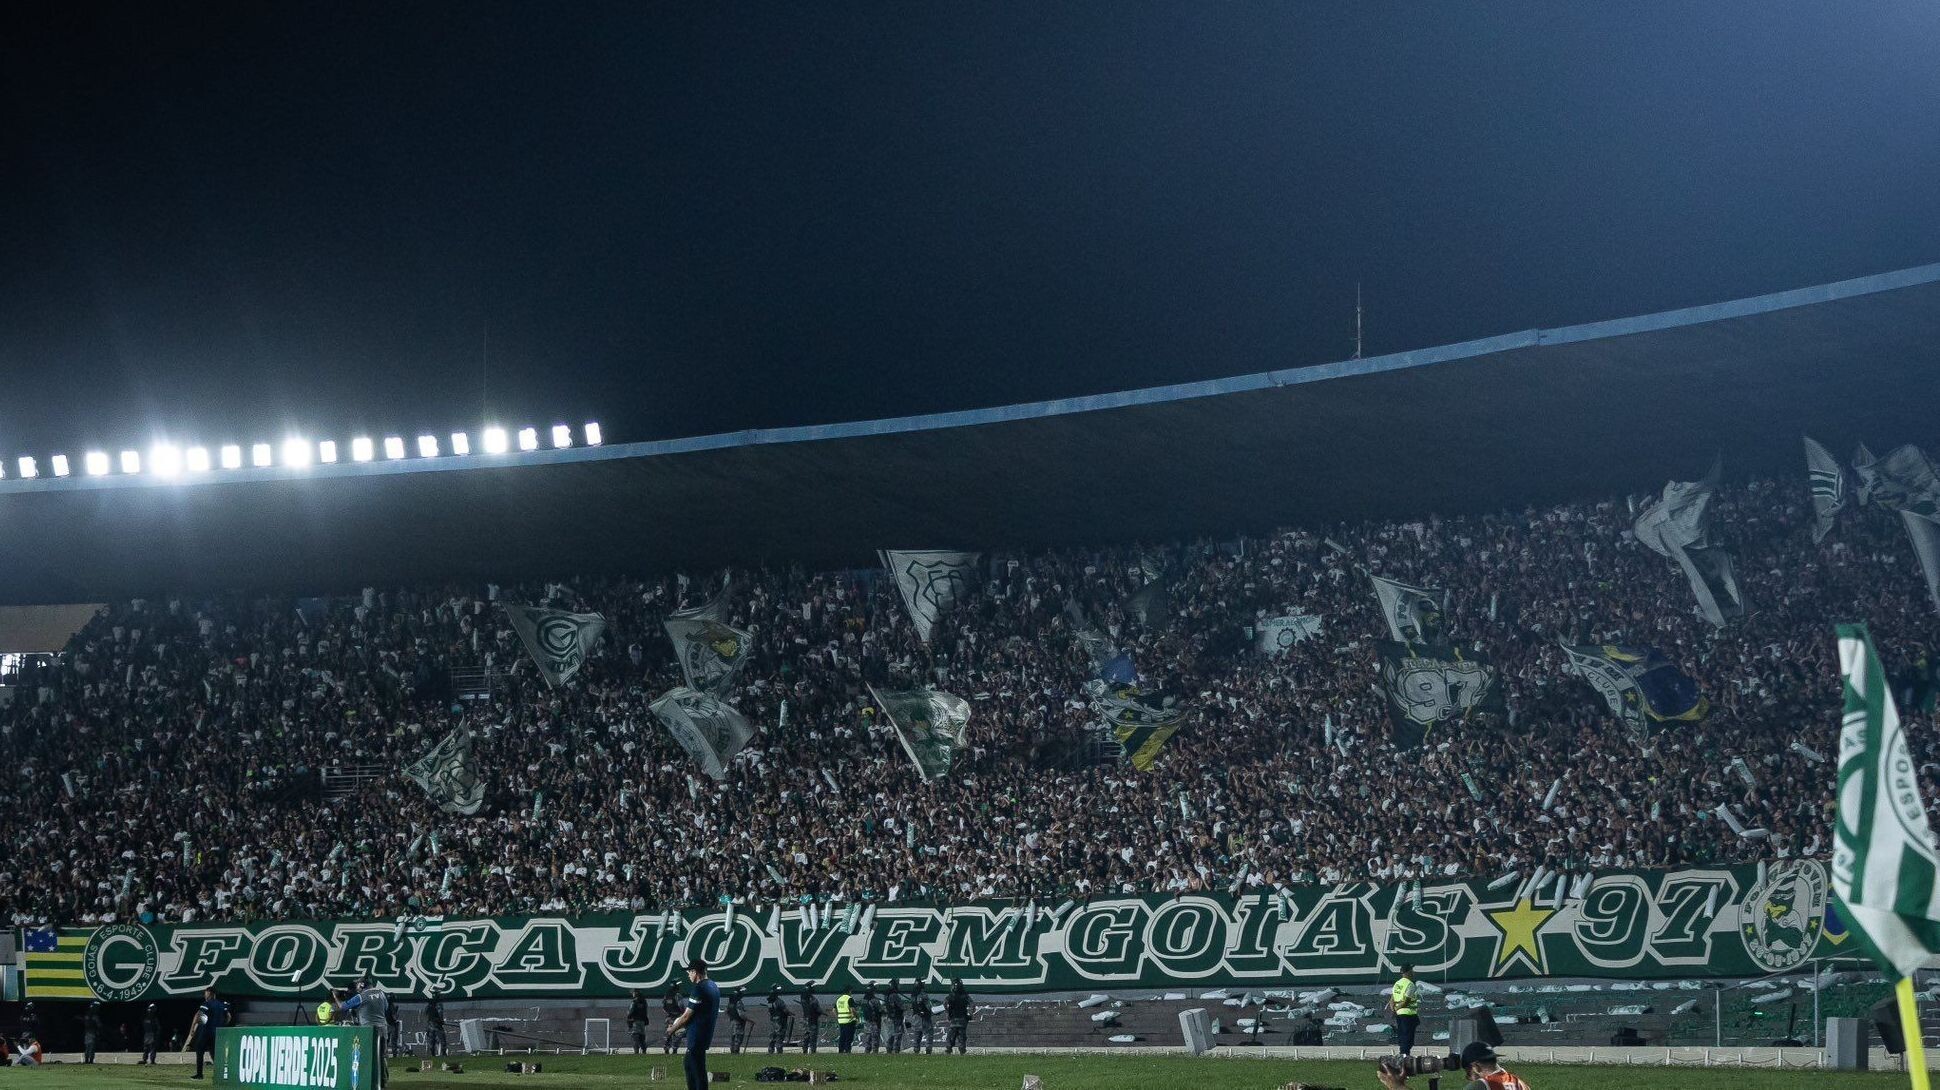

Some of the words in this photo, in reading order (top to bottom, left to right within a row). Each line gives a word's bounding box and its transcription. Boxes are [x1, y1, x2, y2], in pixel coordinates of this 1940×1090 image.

[1588, 672, 1619, 706] CLUBE
[99, 924, 145, 941] ESPORTE
[141, 944, 156, 980] CLUBE
[160, 918, 586, 998] FORÇA
[598, 906, 1047, 990] JOVEM
[1062, 883, 1475, 981] GOIÁS
[1570, 869, 1739, 968] 97
[97, 934, 146, 989] G
[96, 982, 143, 1001] 6-4-1943
[239, 1034, 268, 1083] COPA
[269, 1036, 310, 1087] VERDE
[309, 1037, 339, 1088] 2025
